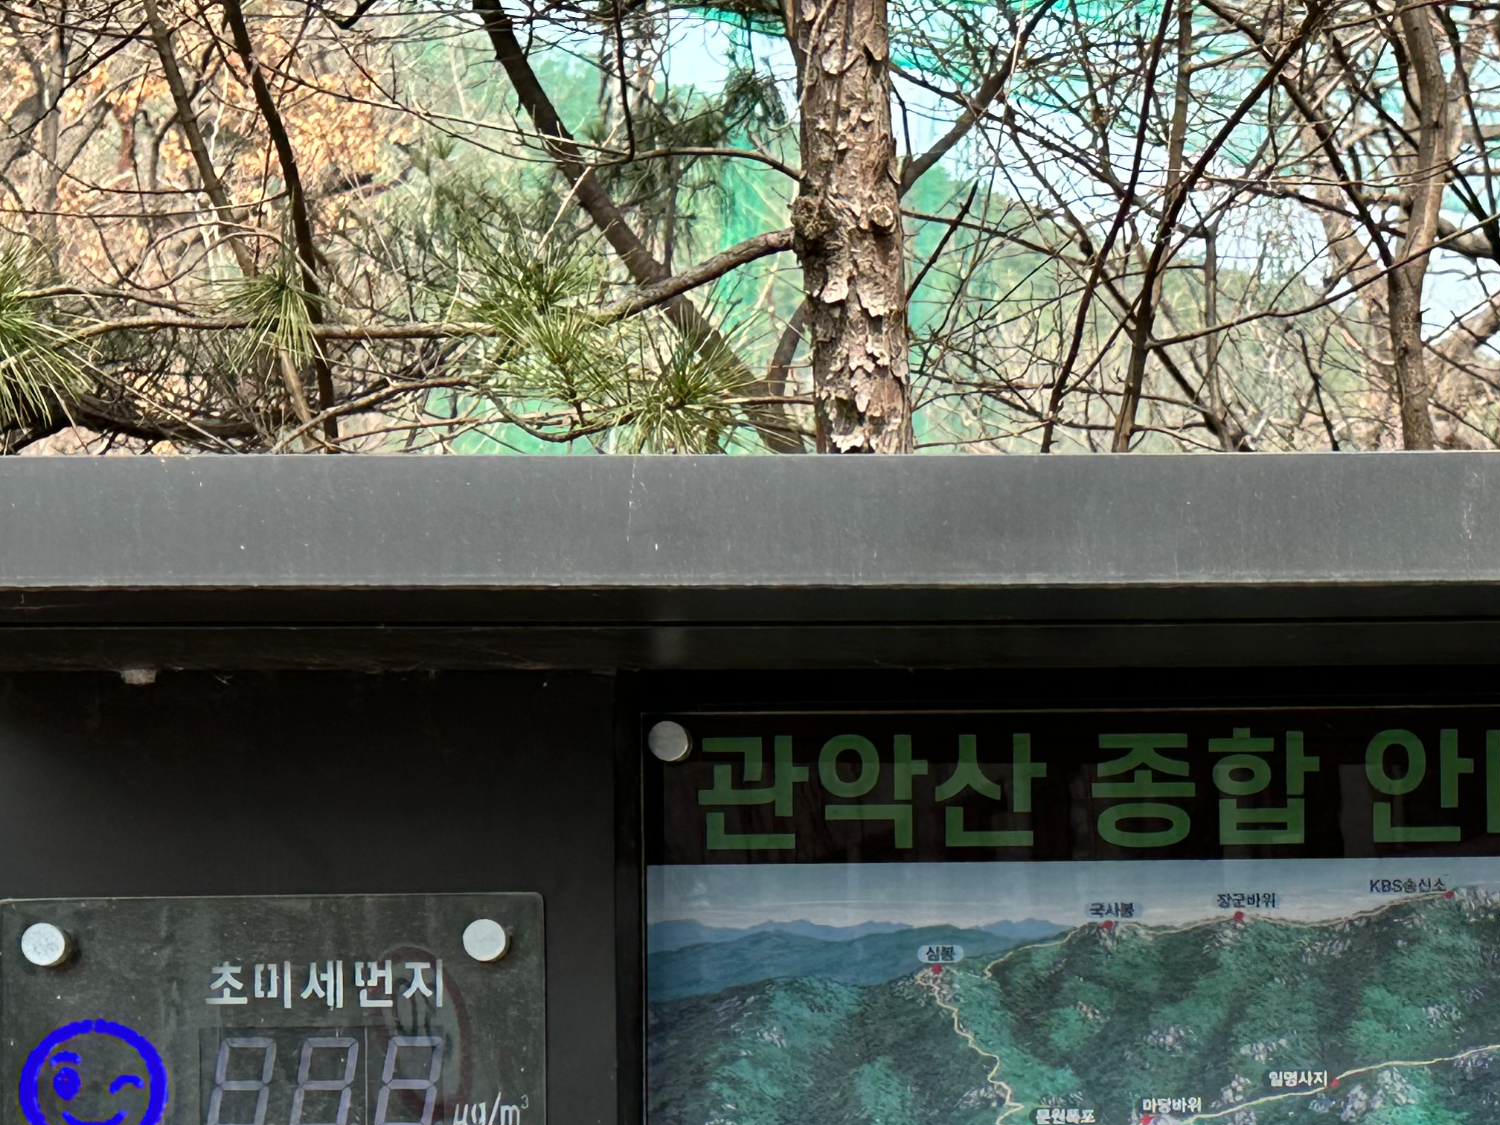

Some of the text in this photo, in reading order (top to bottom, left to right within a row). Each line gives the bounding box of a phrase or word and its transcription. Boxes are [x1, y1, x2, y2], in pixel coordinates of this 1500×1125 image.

[696, 733, 1047, 850] 관악산
[1090, 727, 1320, 850] 종합
[1217, 893, 1276, 908] 장군바위
[205, 959, 444, 1008] 초미세먼지
[1142, 1097, 1201, 1114] 마당바위
